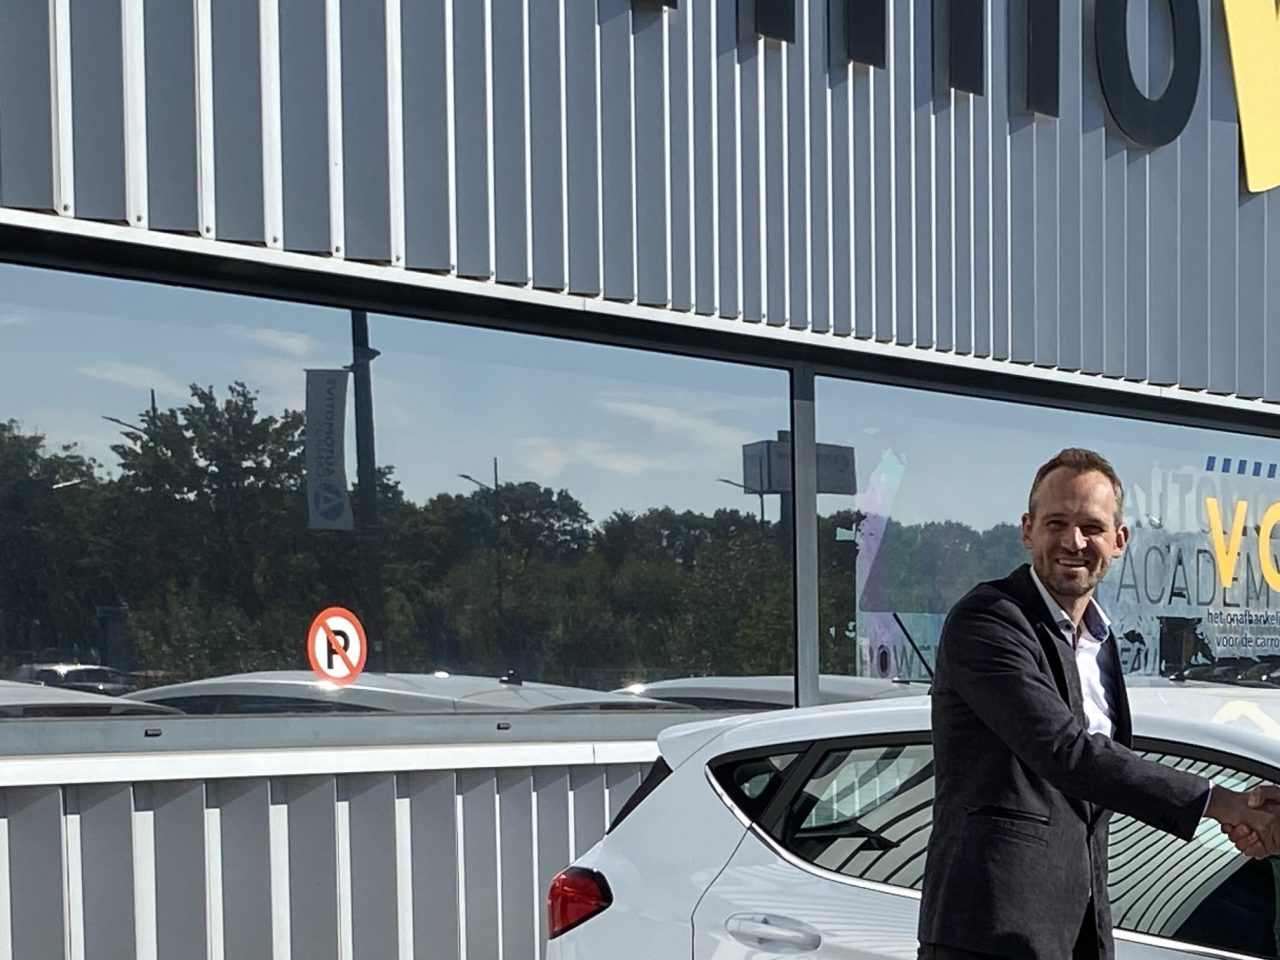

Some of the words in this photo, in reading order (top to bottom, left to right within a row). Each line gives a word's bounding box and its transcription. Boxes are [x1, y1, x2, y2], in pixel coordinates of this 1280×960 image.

[1207, 609, 1223, 624] het
[1216, 636, 1238, 648] voor
[1242, 633, 1253, 648] de
[326, 629, 350, 670] P
